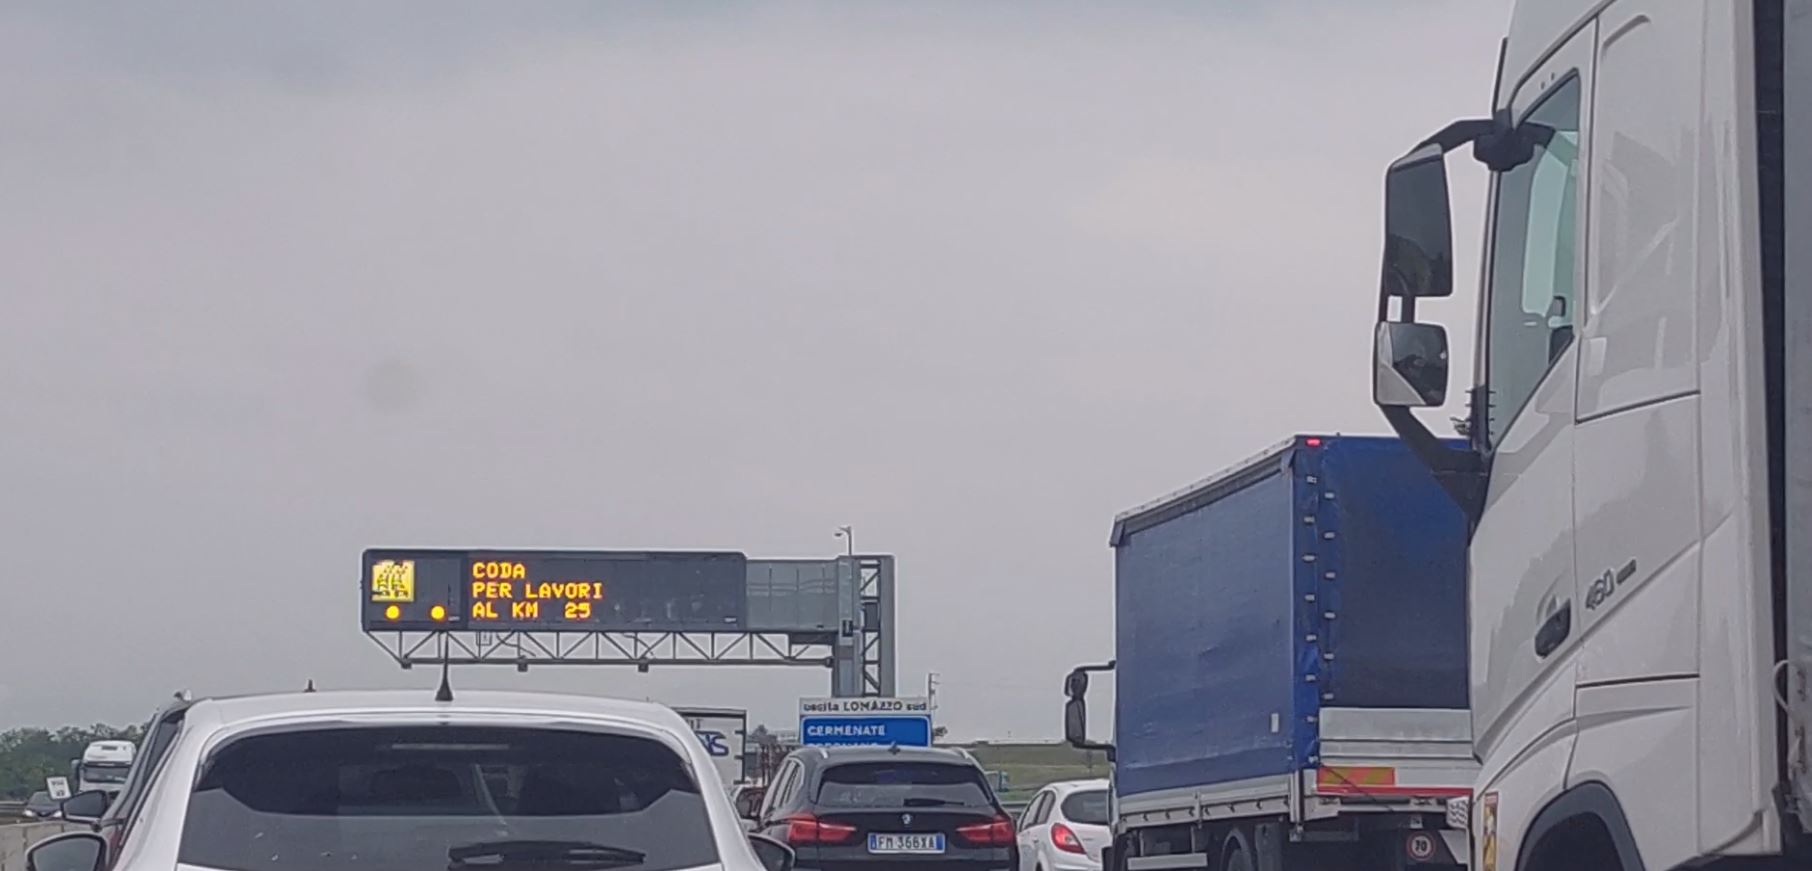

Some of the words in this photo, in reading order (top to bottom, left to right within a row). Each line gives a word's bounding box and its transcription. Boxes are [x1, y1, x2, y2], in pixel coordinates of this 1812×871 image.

[472, 562, 526, 579] CODA
[472, 581, 513, 598] PER
[525, 582, 603, 599] LAVORI
[472, 601, 499, 618] AL
[511, 601, 539, 618] KM
[564, 601, 592, 619] 25
[803, 701, 839, 712] uscita
[843, 700, 903, 712] LOMAZZO
[906, 701, 927, 712] sud
[806, 724, 886, 737] CERMENATE
[1414, 839, 1428, 853] 70
